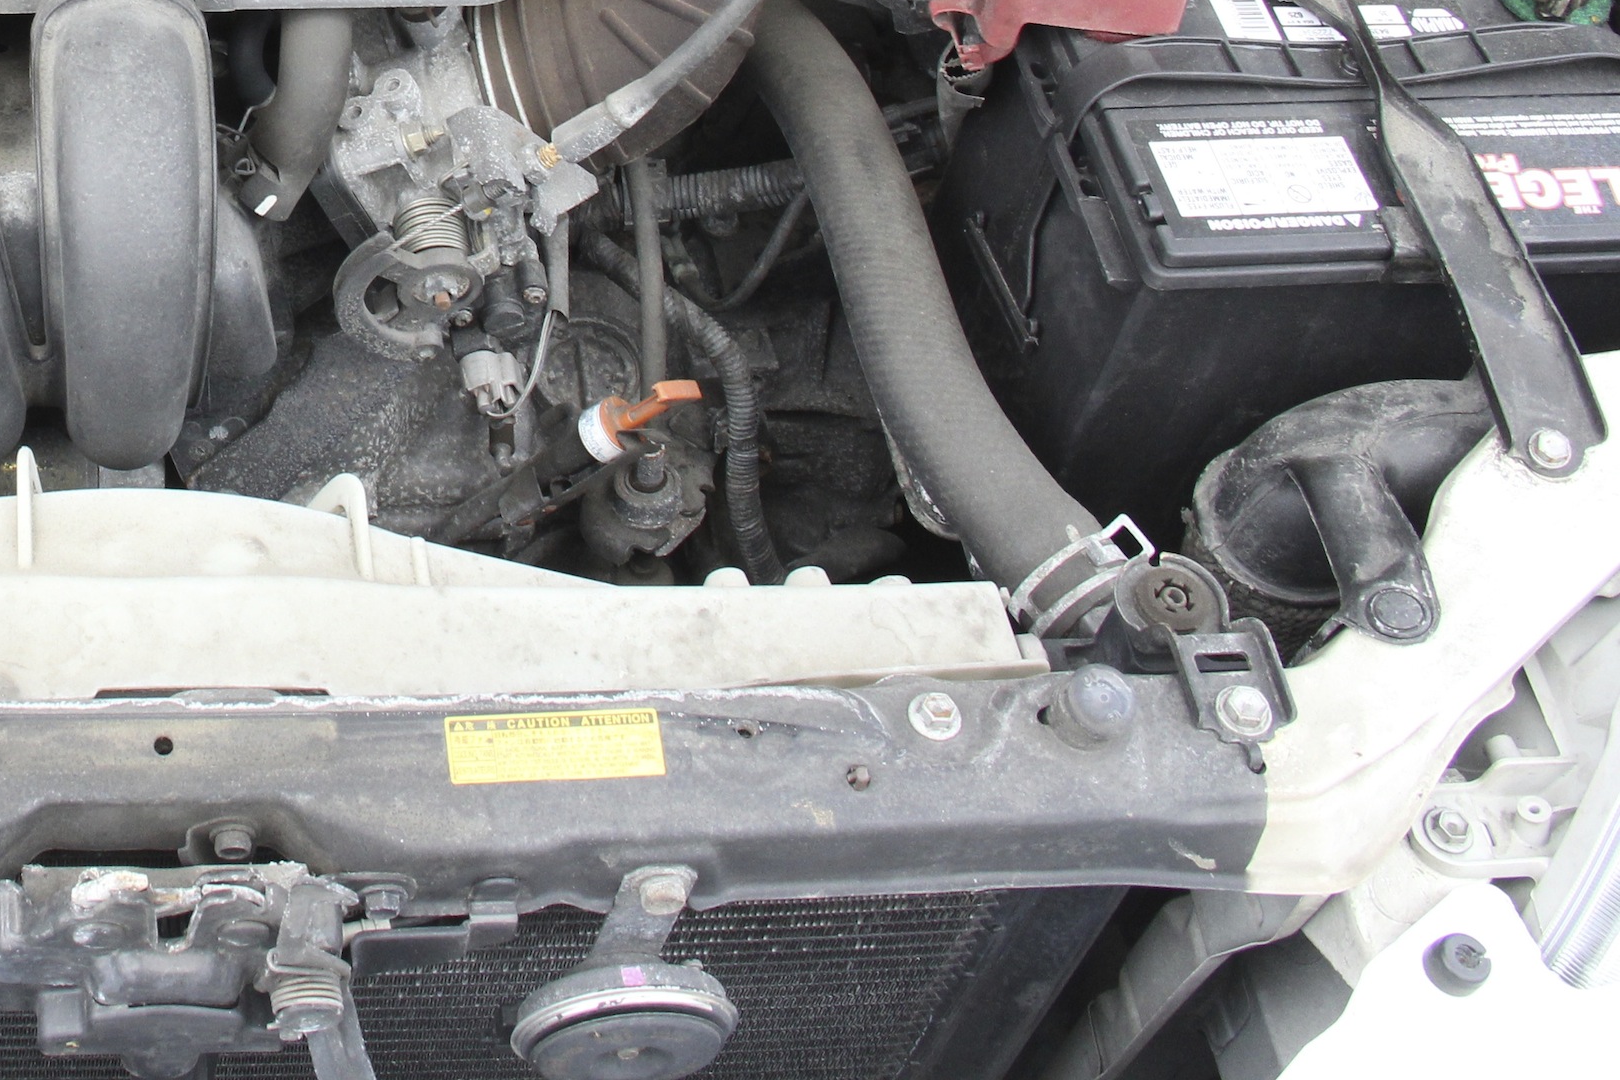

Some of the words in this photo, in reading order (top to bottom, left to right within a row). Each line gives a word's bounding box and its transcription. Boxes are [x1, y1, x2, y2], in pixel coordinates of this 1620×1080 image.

[1573, 205, 1602, 215] THE
[1207, 215, 1347, 231] DANGER/POISON
[507, 716, 571, 729] CAUTION
[581, 713, 650, 727] ATTENTION
